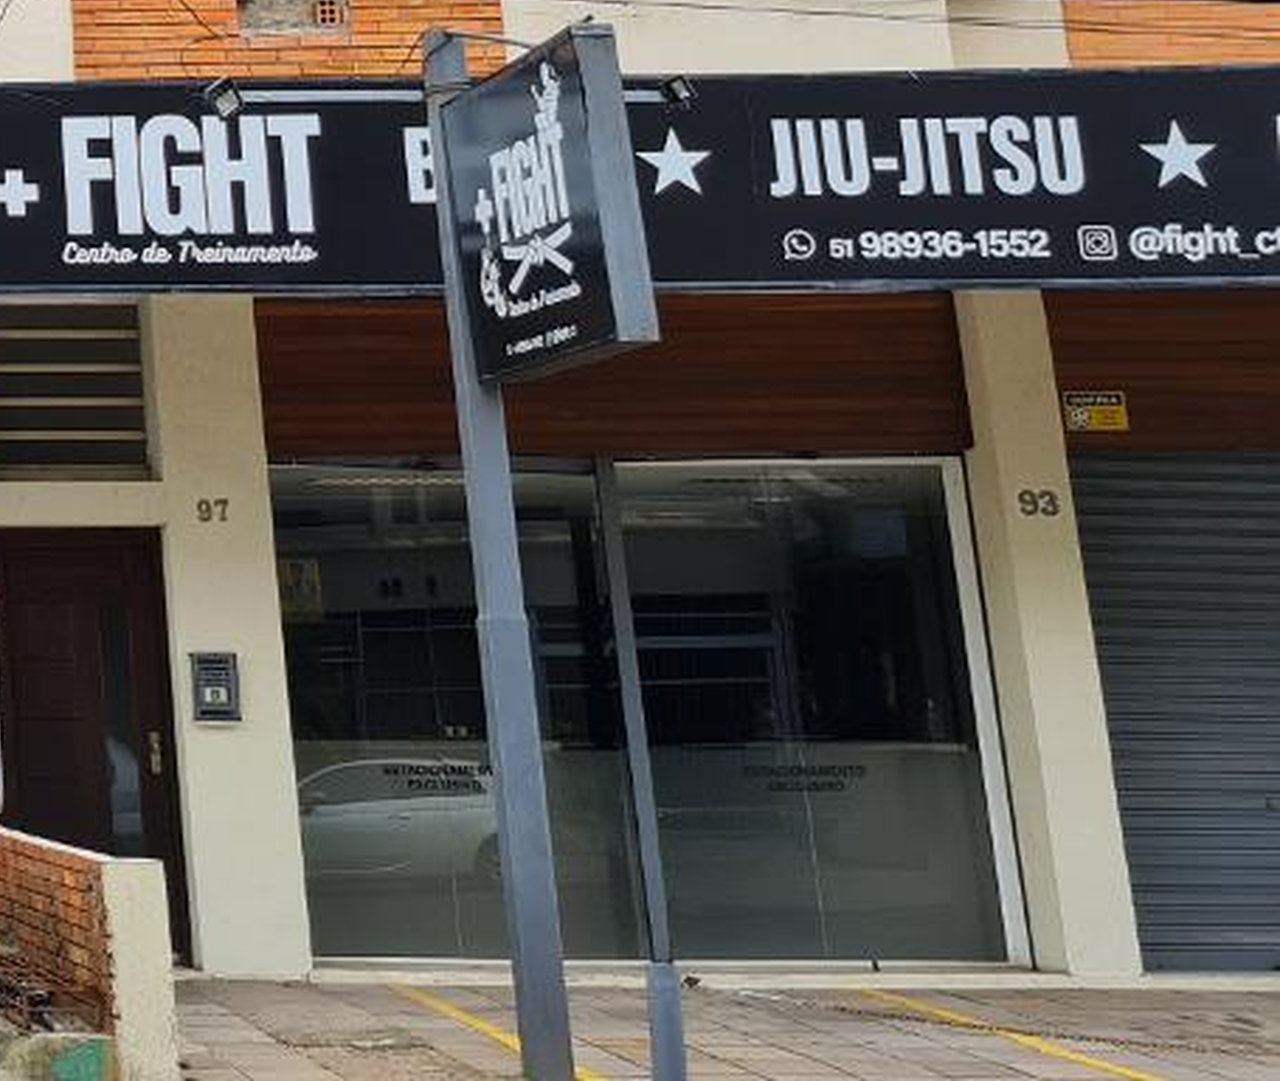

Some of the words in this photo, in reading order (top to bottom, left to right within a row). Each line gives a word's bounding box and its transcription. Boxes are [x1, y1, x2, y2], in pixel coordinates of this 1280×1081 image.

[769, 116, 1086, 198] JIU-JITSU
[61, 114, 322, 236] FIGHT
[490, 114, 570, 243] FIGHT
[62, 242, 138, 264] Centro
[141, 244, 172, 263] de
[178, 240, 318, 264] Treinamento
[829, 239, 854, 258] 51
[860, 230, 1051, 258] 98936-1552
[196, 498, 230, 522] 97
[1017, 489, 1060, 516] 93
